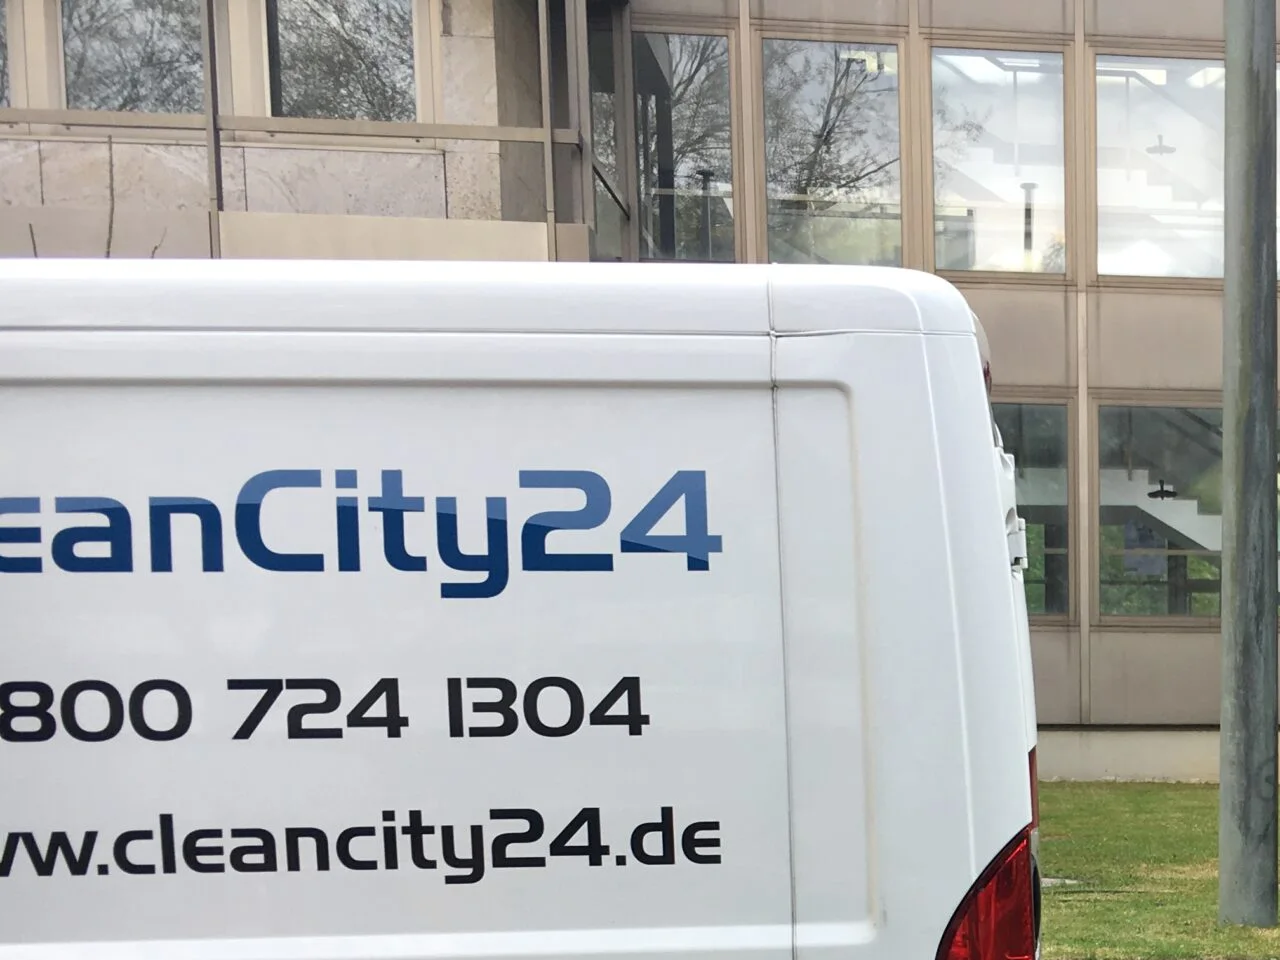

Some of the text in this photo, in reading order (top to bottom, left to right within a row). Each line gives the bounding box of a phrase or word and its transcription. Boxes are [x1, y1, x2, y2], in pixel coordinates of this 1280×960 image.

[0, 677, 650, 742] 800 724 1304
[0, 806, 721, 884] w.cleancity24.de
